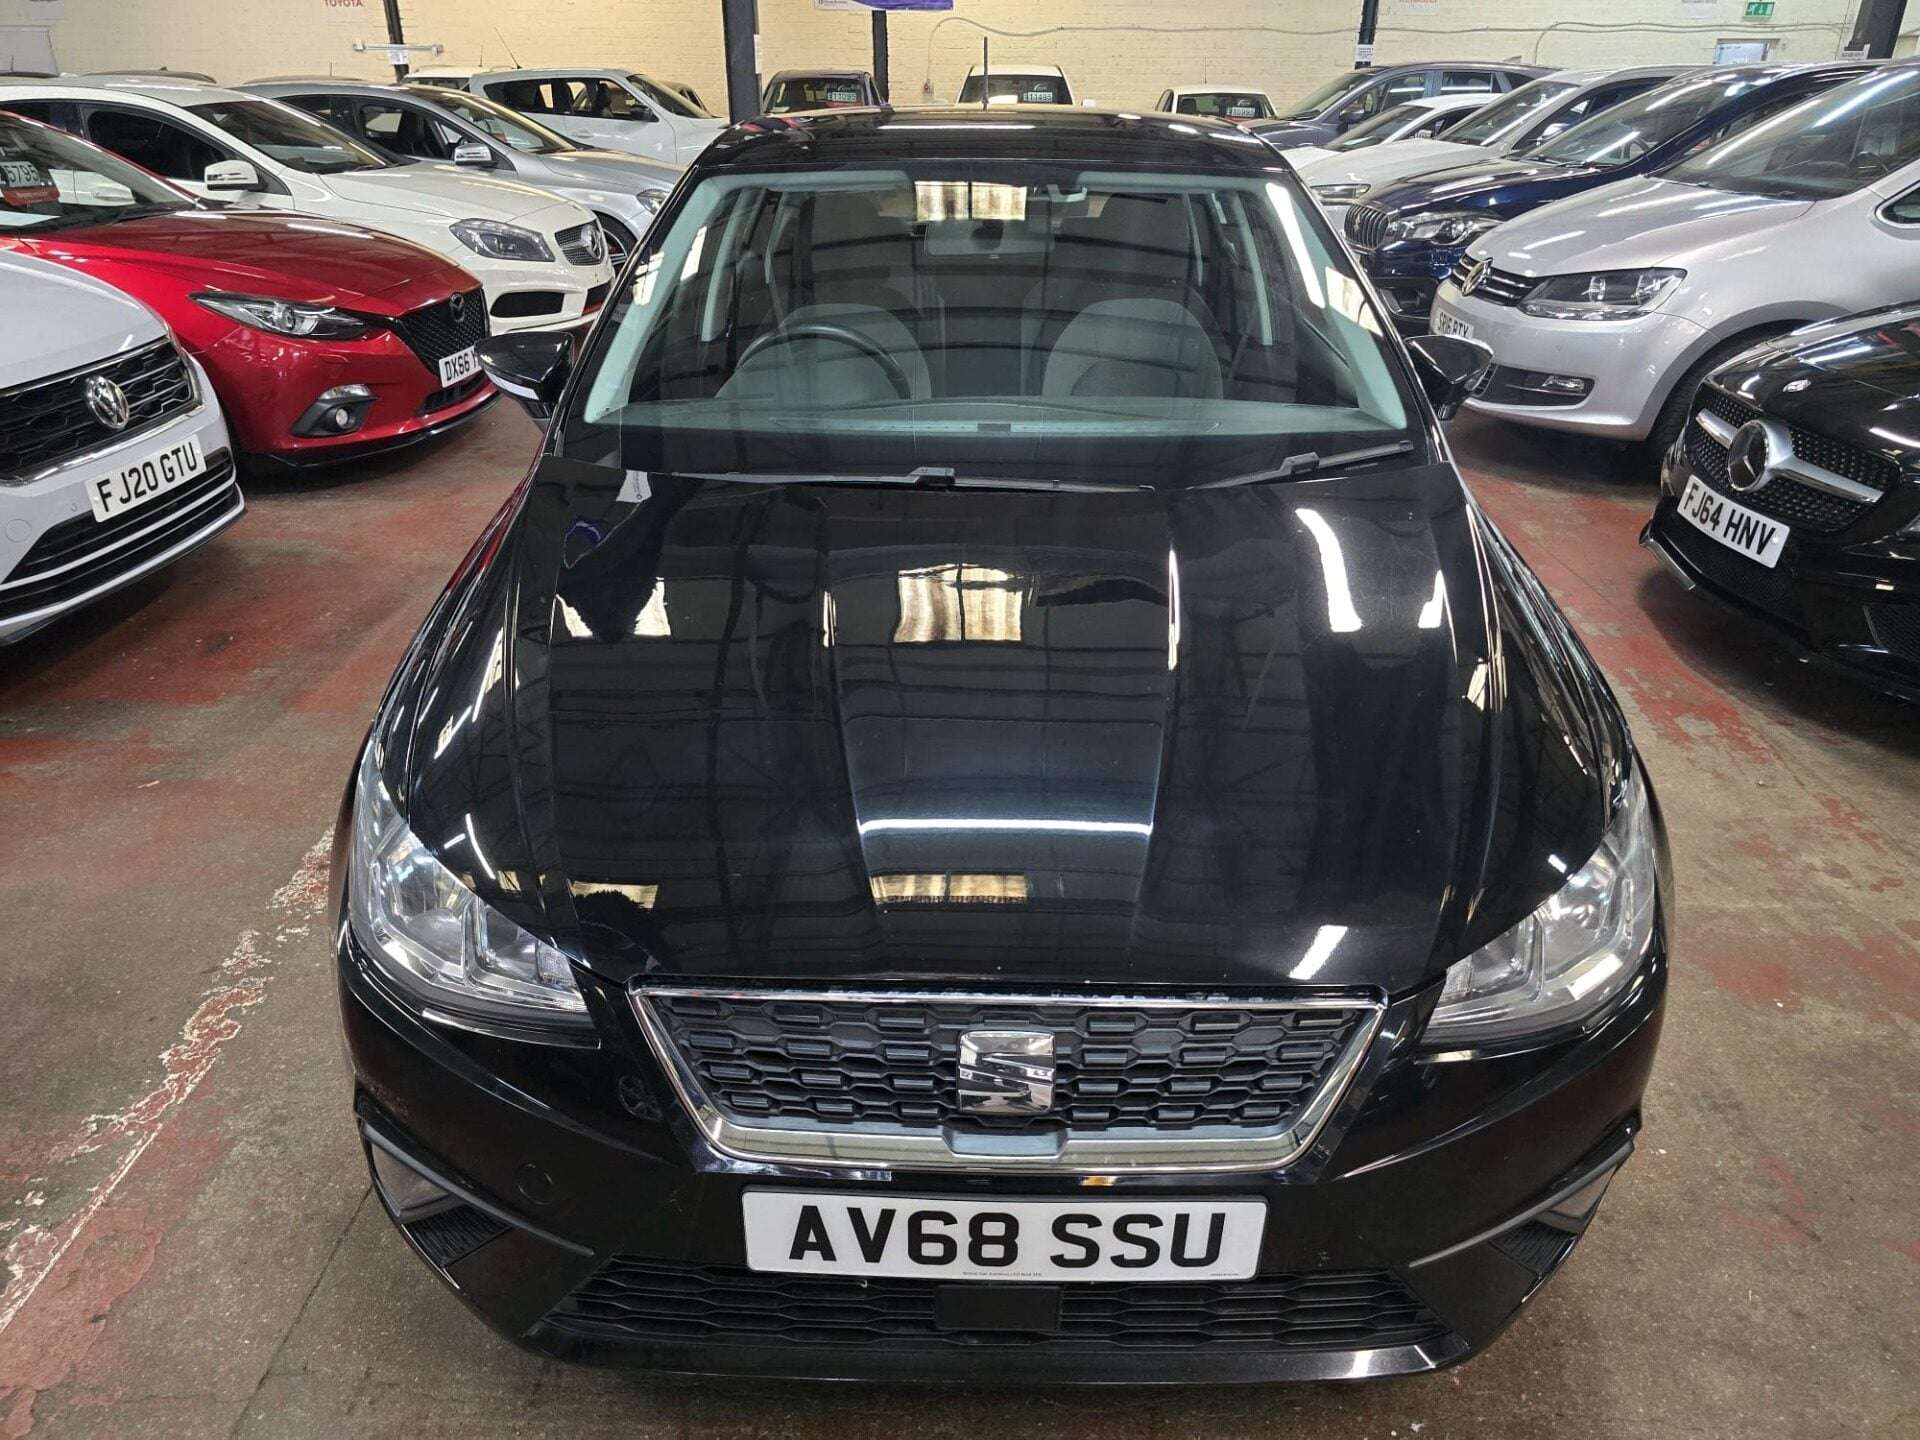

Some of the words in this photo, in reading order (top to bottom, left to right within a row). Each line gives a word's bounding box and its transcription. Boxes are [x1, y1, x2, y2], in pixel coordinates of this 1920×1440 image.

[96, 460, 157, 513] FJ20
[159, 441, 198, 484] GTU
[1683, 482, 1724, 532] FJ64
[1722, 508, 1777, 556] HNV
[788, 1204, 1020, 1267] AV68
[1050, 1212, 1227, 1269] SSU
